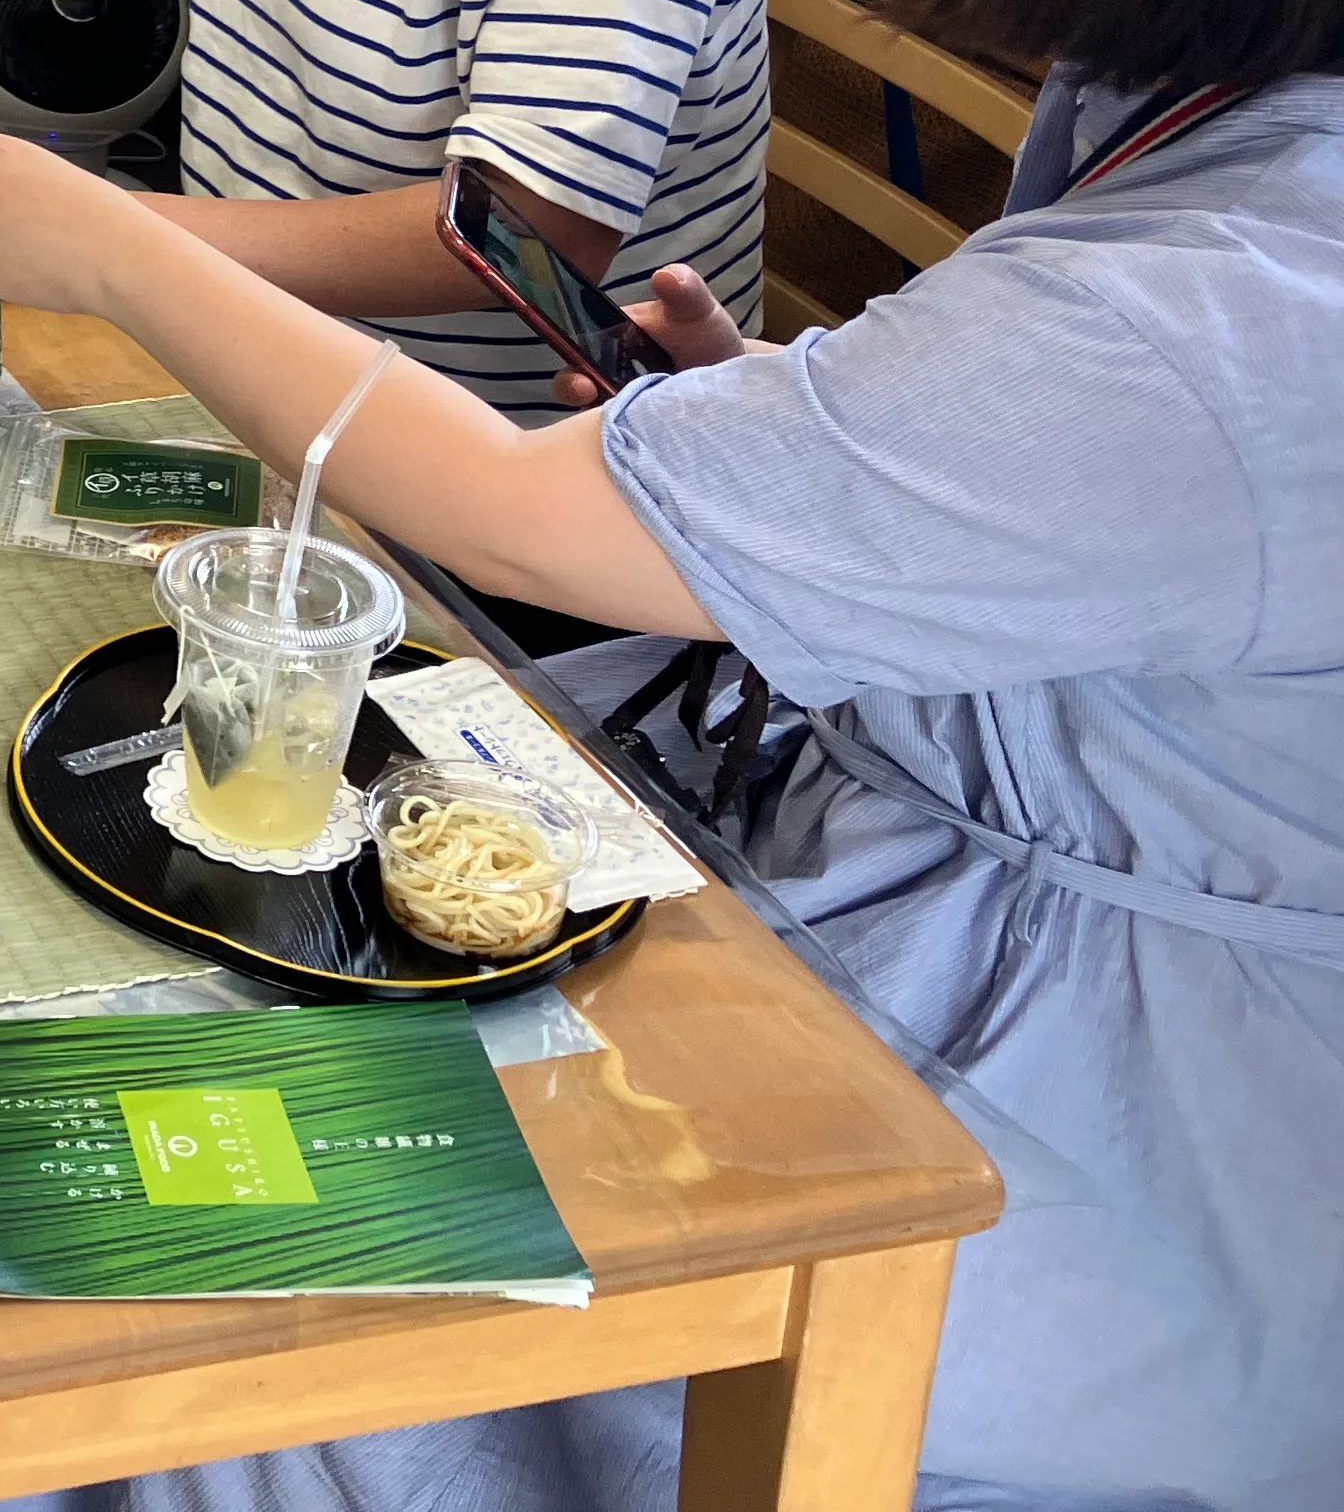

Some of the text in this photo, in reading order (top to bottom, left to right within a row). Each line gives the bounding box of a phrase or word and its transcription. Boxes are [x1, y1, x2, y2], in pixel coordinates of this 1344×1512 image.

[125, 484, 207, 497] ふりかけ
[55, 1139, 112, 1151] まぜる
[203, 1095, 254, 1197] IGUSA
[67, 1188, 124, 1201] かける
